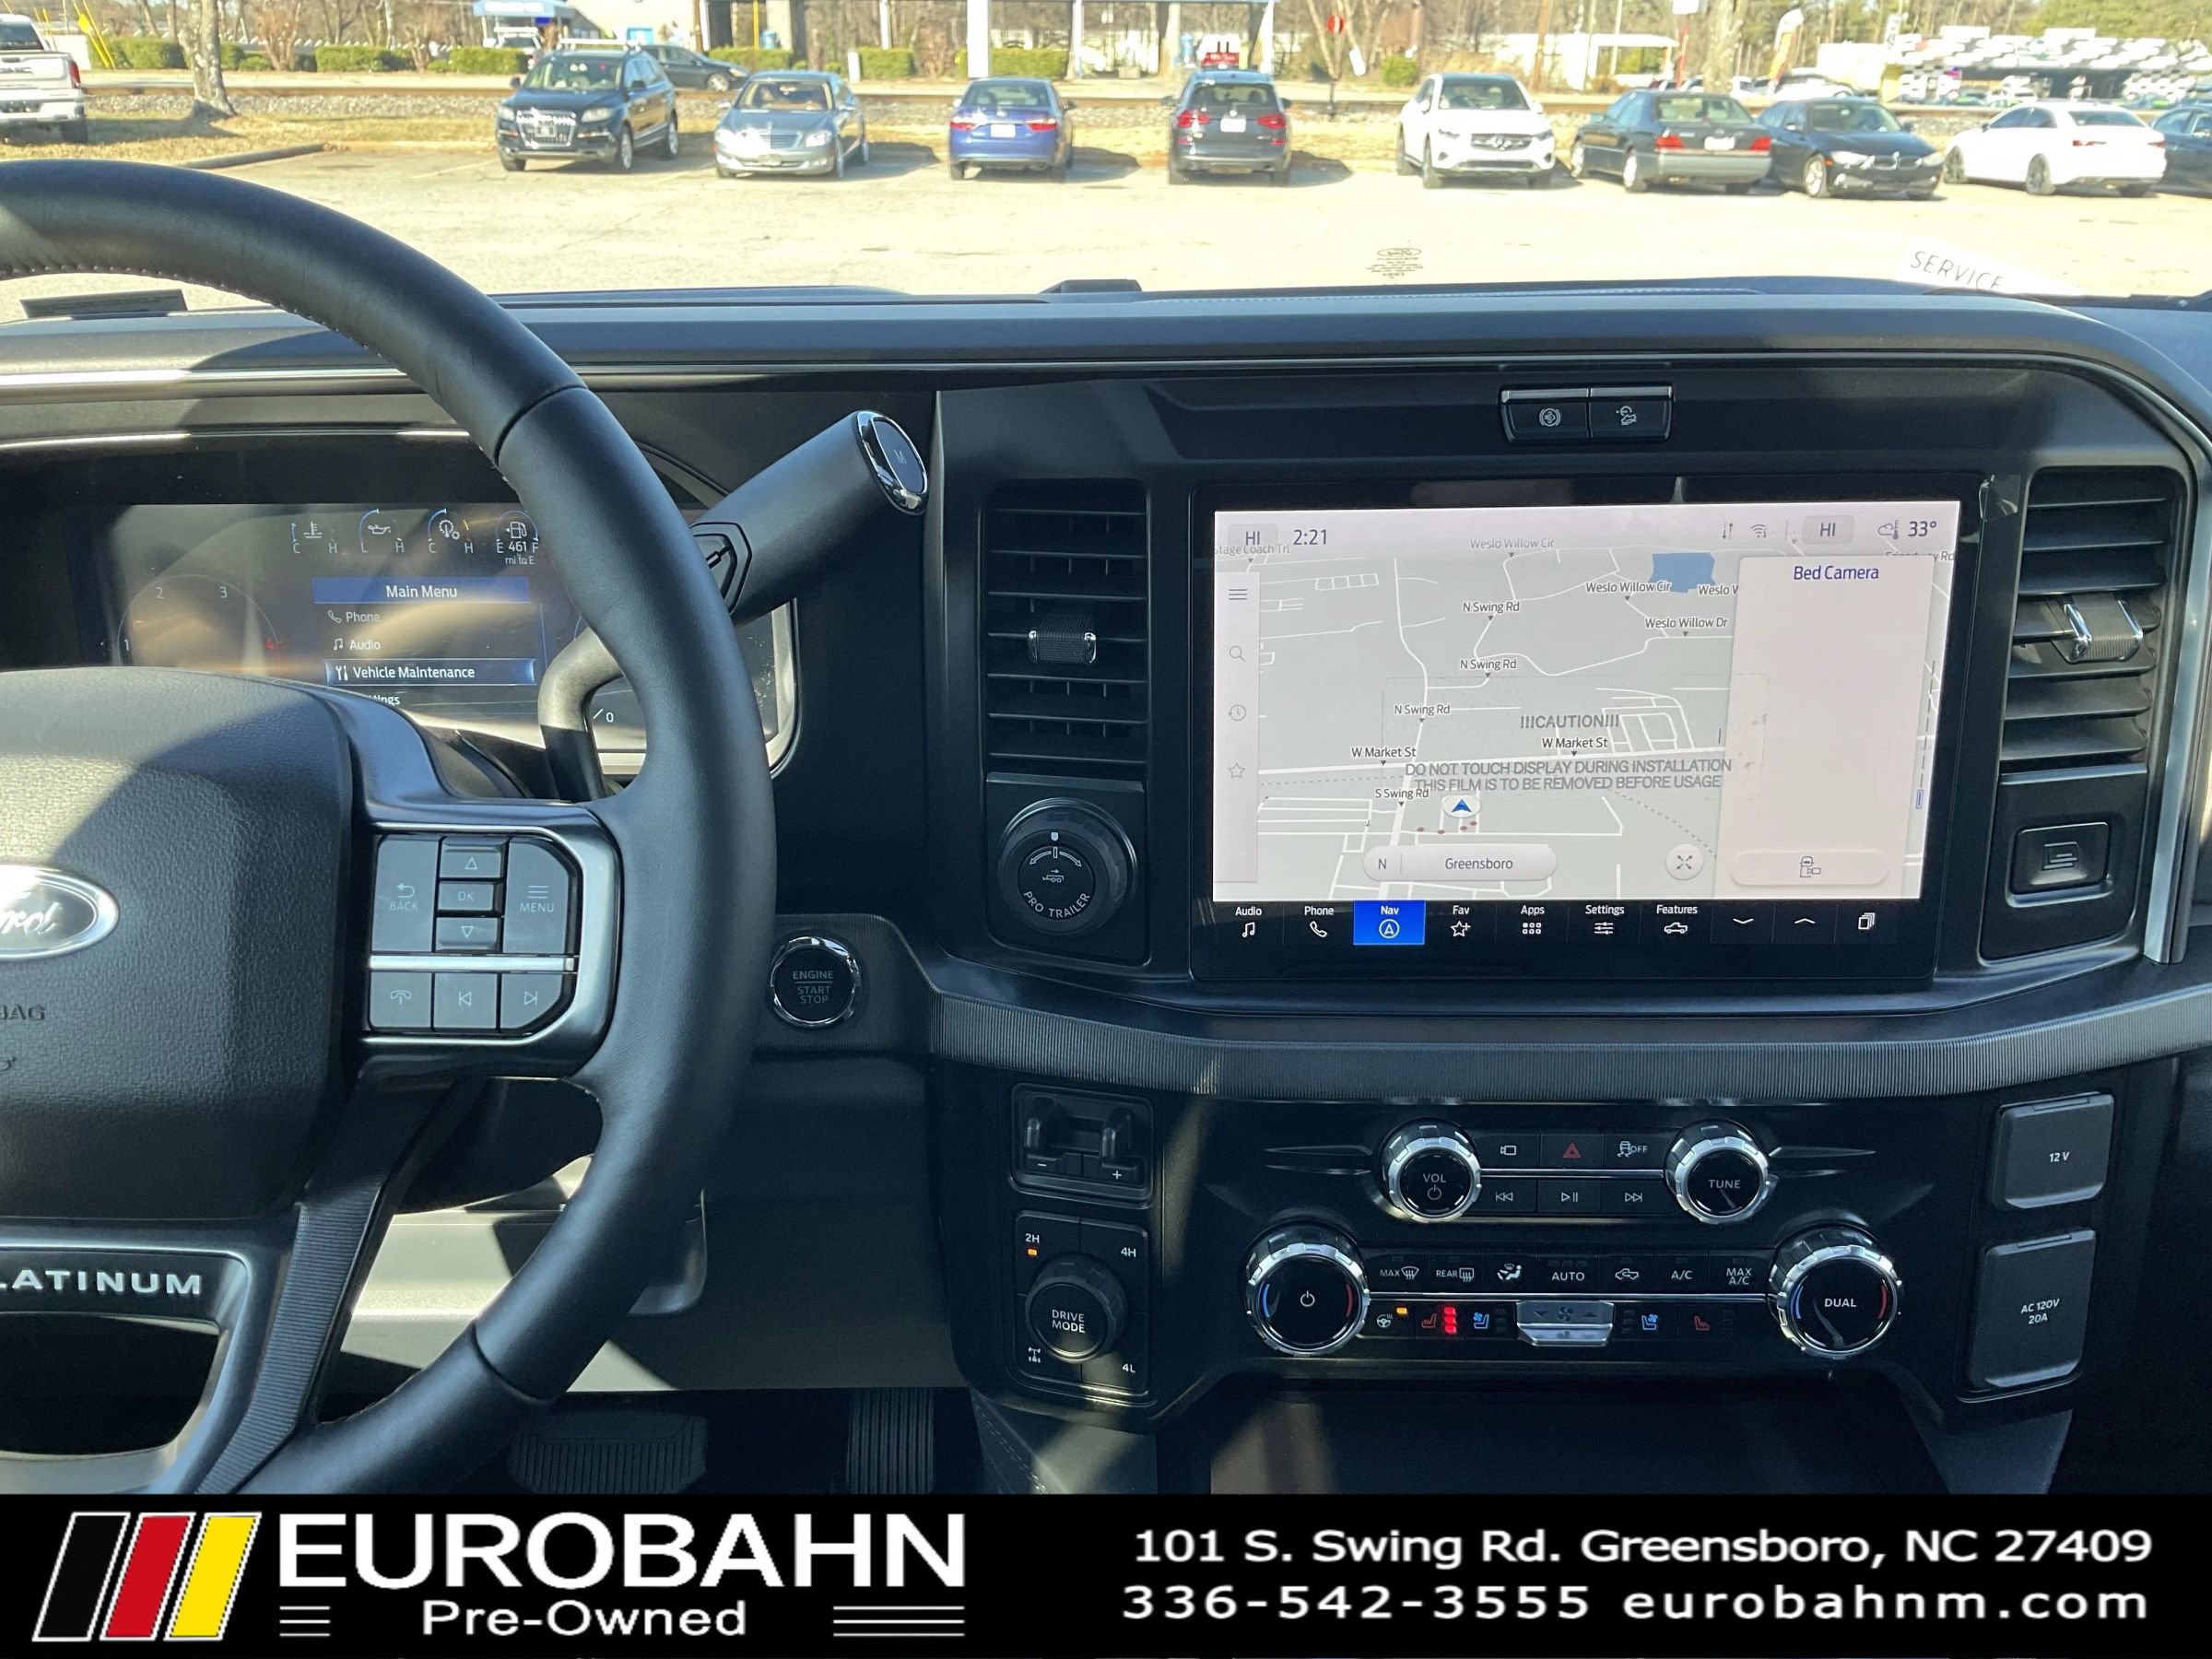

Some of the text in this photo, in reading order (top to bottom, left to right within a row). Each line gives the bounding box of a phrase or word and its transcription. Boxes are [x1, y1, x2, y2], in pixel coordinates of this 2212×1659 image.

[1820, 524, 1835, 536] HI
[1908, 521, 1936, 537] 33°
[1246, 532, 1260, 545] HI
[1293, 530, 1326, 545] 2:21
[1471, 537, 1554, 549] Weslo Willow Cir
[396, 542, 405, 552] H
[465, 543, 473, 553] H
[497, 542, 503, 552] E
[508, 541, 527, 552] 461
[532, 542, 539, 553] F
[1243, 545, 1274, 553] Coach
[1275, 544, 1289, 553] Trl
[505, 556, 516, 564] mi
[518, 556, 527, 564] to
[1794, 566, 1878, 580] Bed Camera
[156, 587, 164, 598] 2
[220, 586, 227, 598] 3
[386, 585, 457, 598] Main Menu
[1586, 582, 1671, 593] Weslo Willow Cir
[1699, 585, 1729, 594] Weslo
[1464, 601, 1519, 613] N Swing Rd
[347, 610, 381, 623] Phone
[1646, 618, 1727, 628] Weslo Willow Dr
[124, 640, 129, 651] 1
[350, 639, 381, 651] Audio
[1460, 658, 1516, 671] N Swing Rd
[353, 665, 476, 679] Vehicle Maintenance
[1394, 704, 1450, 716] N Swing Rd
[1543, 737, 1607, 748] W Market St
[1352, 747, 1416, 758] W Market St
[1406, 759, 1731, 776] DO NOT TOUCH DISPLAY DURING INSTALLATION
[1416, 775, 1721, 792] THIS FILM IS TO BE REMOVED BEFORE USAGE
[1375, 788, 1429, 801] S Swing Rd
[1378, 859, 1386, 869] N
[1445, 858, 1512, 870] Greensboro
[458, 892, 474, 900] OK
[390, 901, 418, 912] BACK
[520, 902, 554, 912] MENU
[1024, 890, 1090, 918] PRO TRAILER
[1585, 904, 1624, 915] Settings
[1657, 904, 1698, 914] Features
[1235, 906, 1262, 916] Audio
[1305, 905, 1334, 915] Phone
[1382, 906, 1399, 915] Nav
[1453, 905, 1470, 915] Fav
[1521, 905, 1545, 916] Apps
[793, 971, 833, 980] ENGINE
[797, 985, 830, 994] START
[800, 994, 829, 1004] STOP
[1630, 1145, 1648, 1154] OFF
[2050, 1151, 2069, 1162] 12 V
[1423, 1173, 1446, 1183] VOL
[1709, 1179, 1741, 1190] TUNE
[1025, 1233, 1040, 1243] 2H
[1121, 1247, 1136, 1257] 4H
[1380, 1269, 1400, 1277] MAX
[1436, 1269, 1458, 1277] REAR
[1552, 1272, 1585, 1281] AUTO
[1671, 1270, 1692, 1280] A/C
[1726, 1267, 1752, 1277] MAX
[1729, 1276, 1749, 1286] A/C
[1825, 1298, 1856, 1308] DUAL
[2021, 1299, 2060, 1314] AC 120V
[1052, 1309, 1085, 1323] DRIVE
[2029, 1312, 2048, 1324] 20A
[1052, 1320, 1085, 1333] MODE
[1123, 1363, 1135, 1373] 4L
